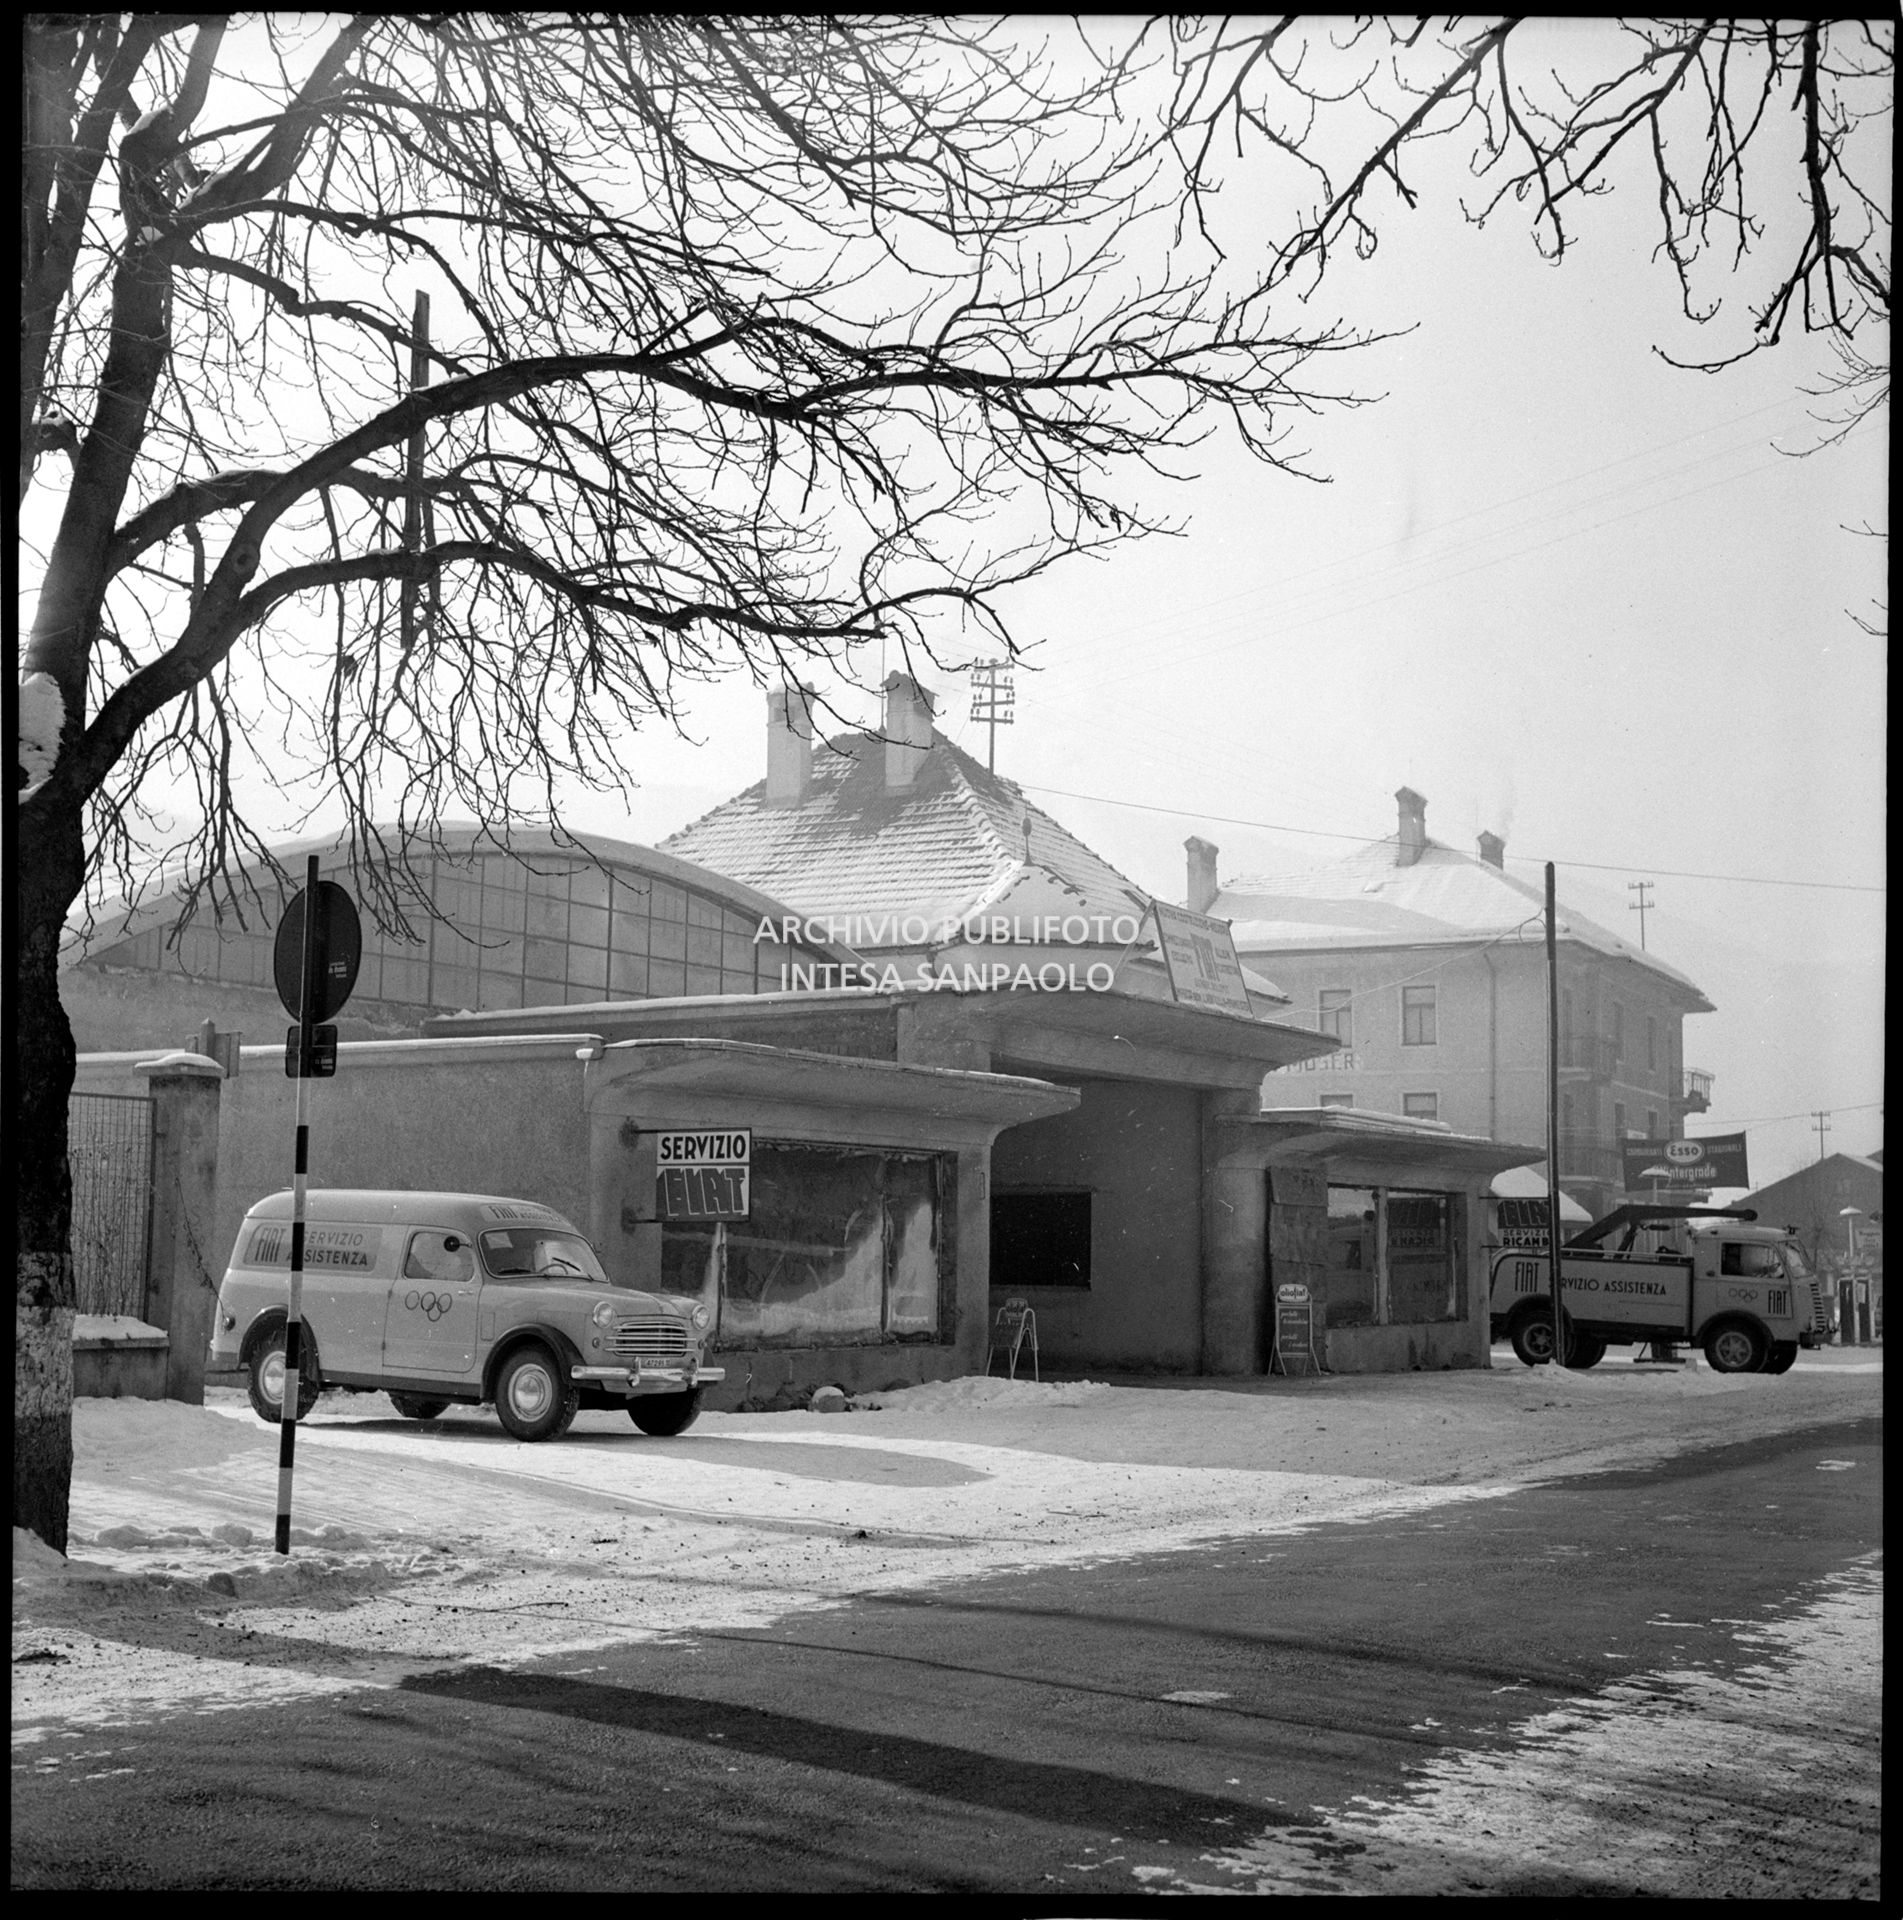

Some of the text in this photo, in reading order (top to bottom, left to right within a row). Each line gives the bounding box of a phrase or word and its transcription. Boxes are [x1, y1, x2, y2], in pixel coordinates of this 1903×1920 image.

[661, 1135, 747, 1160] SERVIZIO
[664, 1168, 747, 1216] FIAT
[488, 1205, 519, 1219] FIAT
[254, 1227, 287, 1262] FIAT
[1503, 1229, 1549, 1237] SERVIZI
[286, 1249, 368, 1266] ASISTENZA
[1515, 1261, 1667, 1296] FIAT RVIZIO ASSISTENZA
[1768, 1290, 1787, 1315] FIAT
